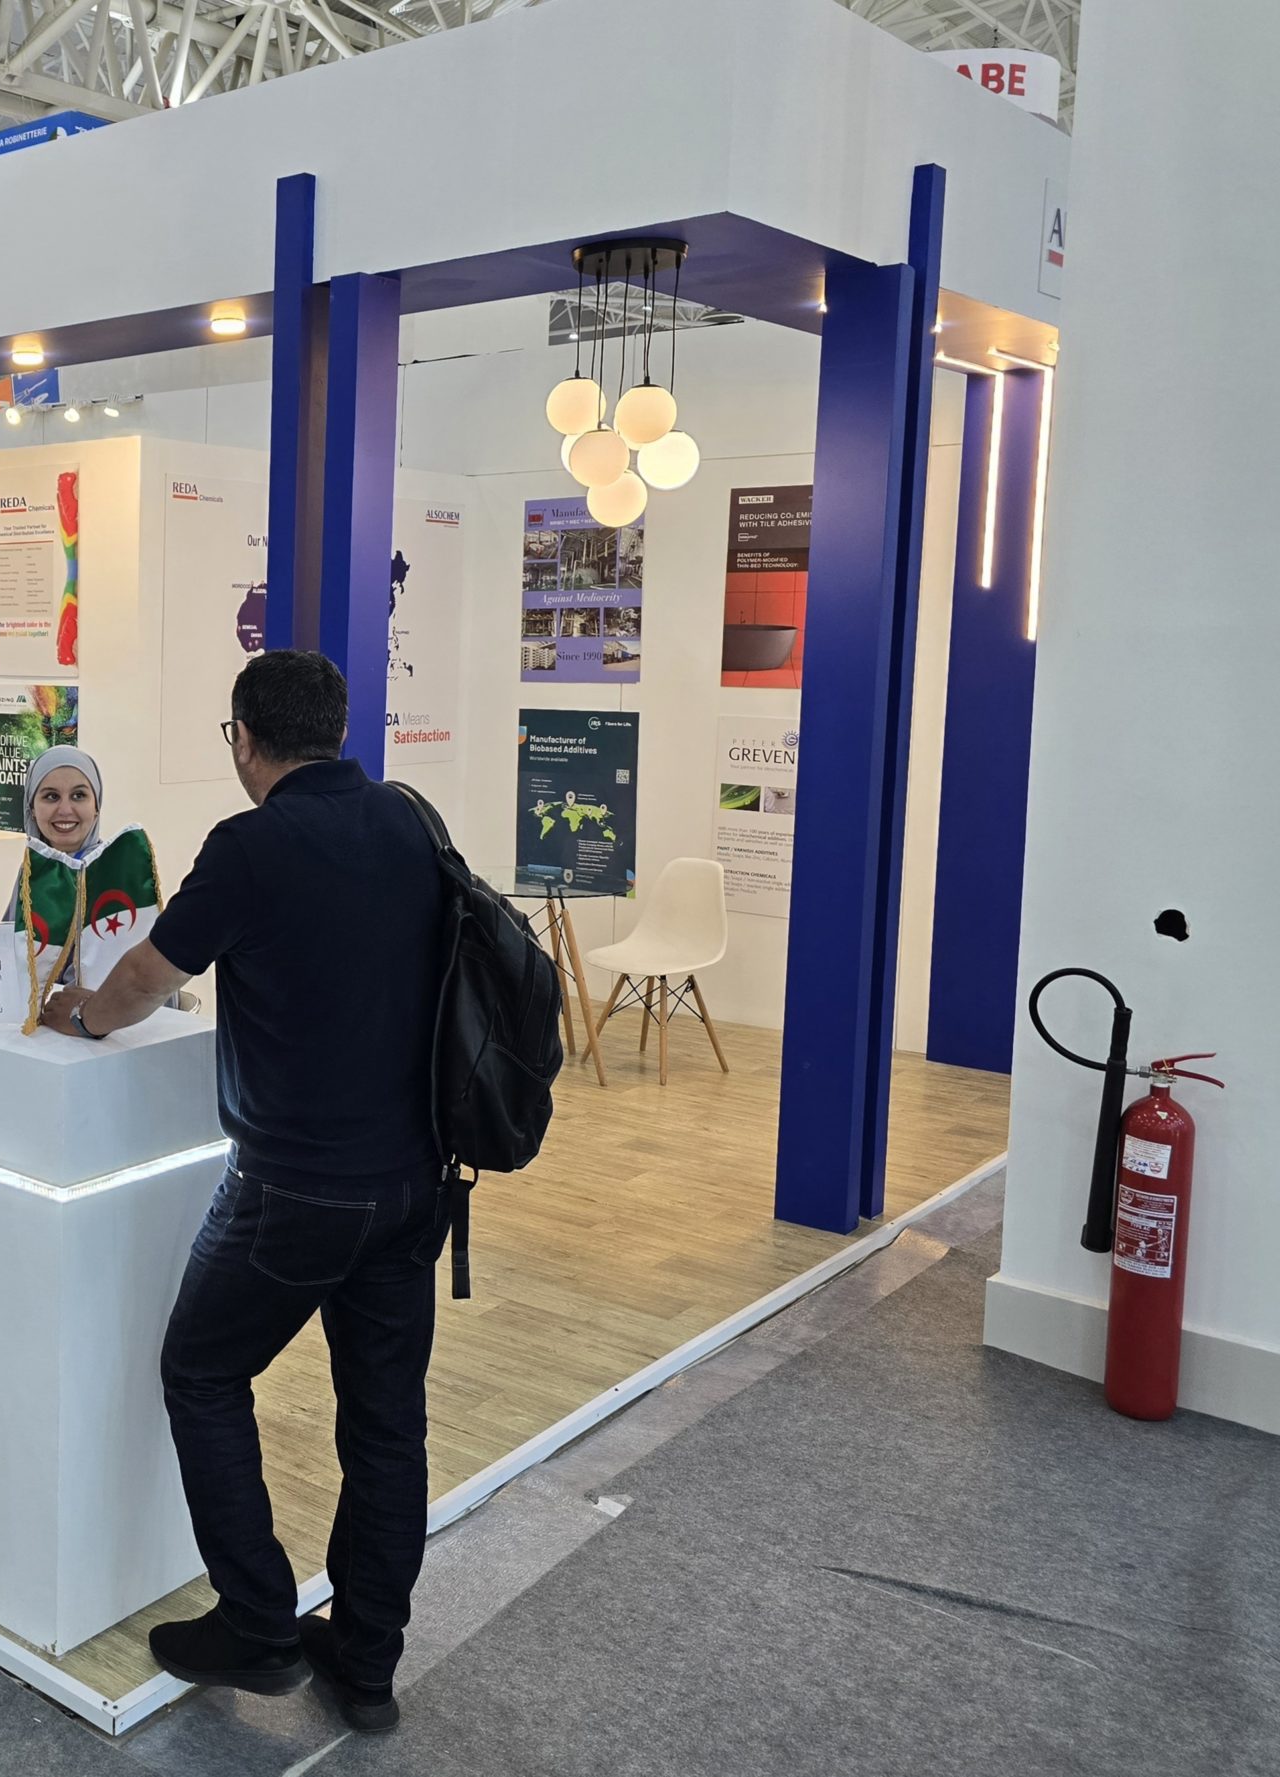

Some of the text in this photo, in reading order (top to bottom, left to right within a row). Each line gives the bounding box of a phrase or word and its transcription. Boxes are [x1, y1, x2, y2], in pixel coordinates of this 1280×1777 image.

[5, 126, 47, 146] ROBINETTERIE
[172, 482, 198, 495] REDA
[0, 496, 27, 508] REDA
[426, 509, 460, 521] ALSOCHEM
[552, 508, 586, 517] Manufac
[248, 534, 268, 547] Our N
[543, 592, 622, 605] Against Mediocrity
[557, 652, 602, 660] Since 1990
[386, 712, 430, 726] DA Means
[394, 729, 451, 745] Satisfaction
[530, 735, 576, 744] Manufacturer
[530, 744, 598, 754] Biobased Additives
[729, 747, 795, 764] GREVEN
